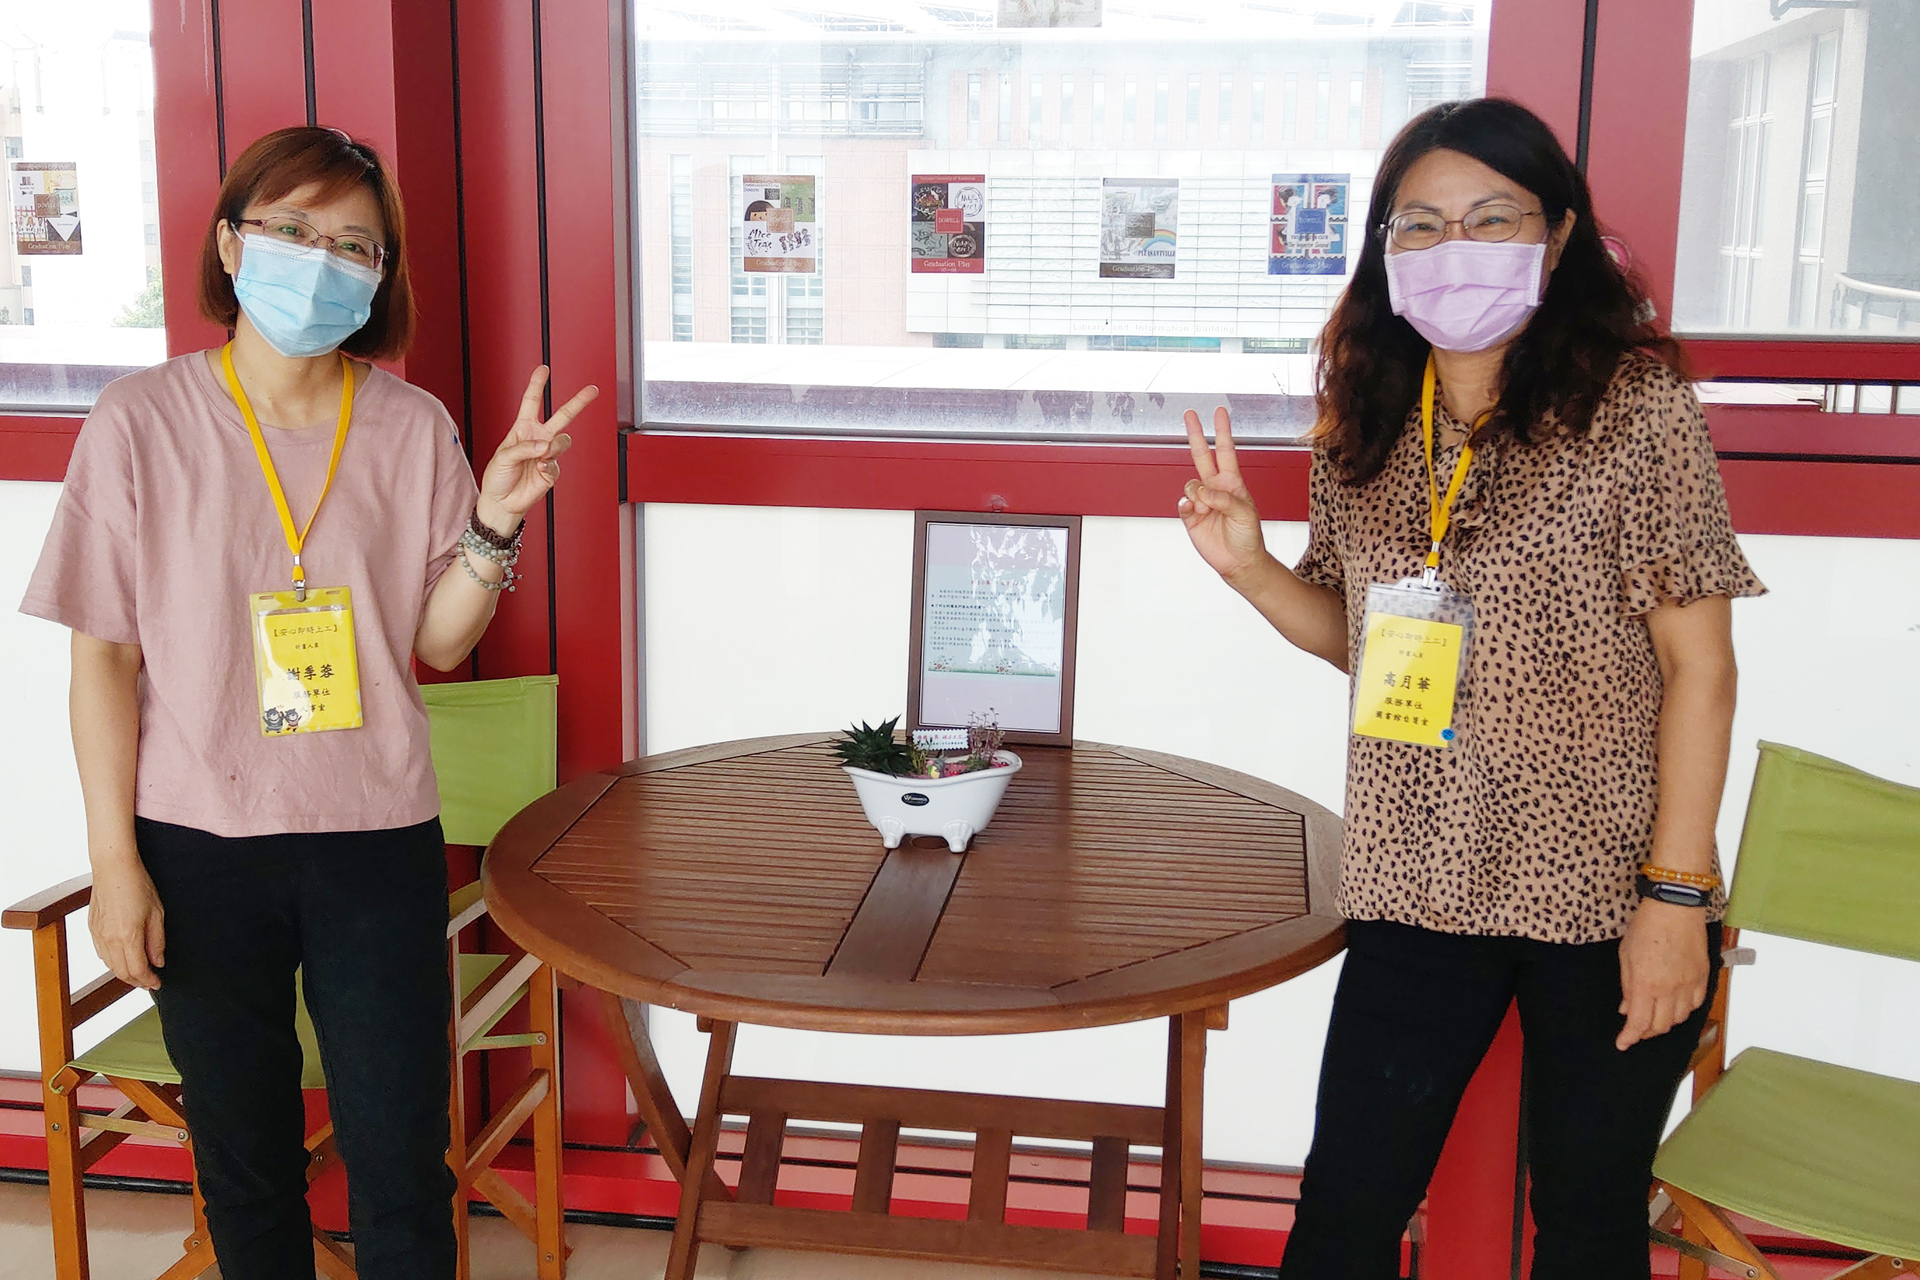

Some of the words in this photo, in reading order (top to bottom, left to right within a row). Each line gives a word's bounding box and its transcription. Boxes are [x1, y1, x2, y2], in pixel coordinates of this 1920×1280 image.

[923, 260, 956, 268] Graduation
[1073, 323, 1106, 333] Library
[1112, 323, 1129, 332] and
[1135, 323, 1190, 333] Information
[1196, 323, 1235, 334] Building
[1384, 671, 1431, 692] 高月華
[1384, 697, 1423, 709] 服務單位
